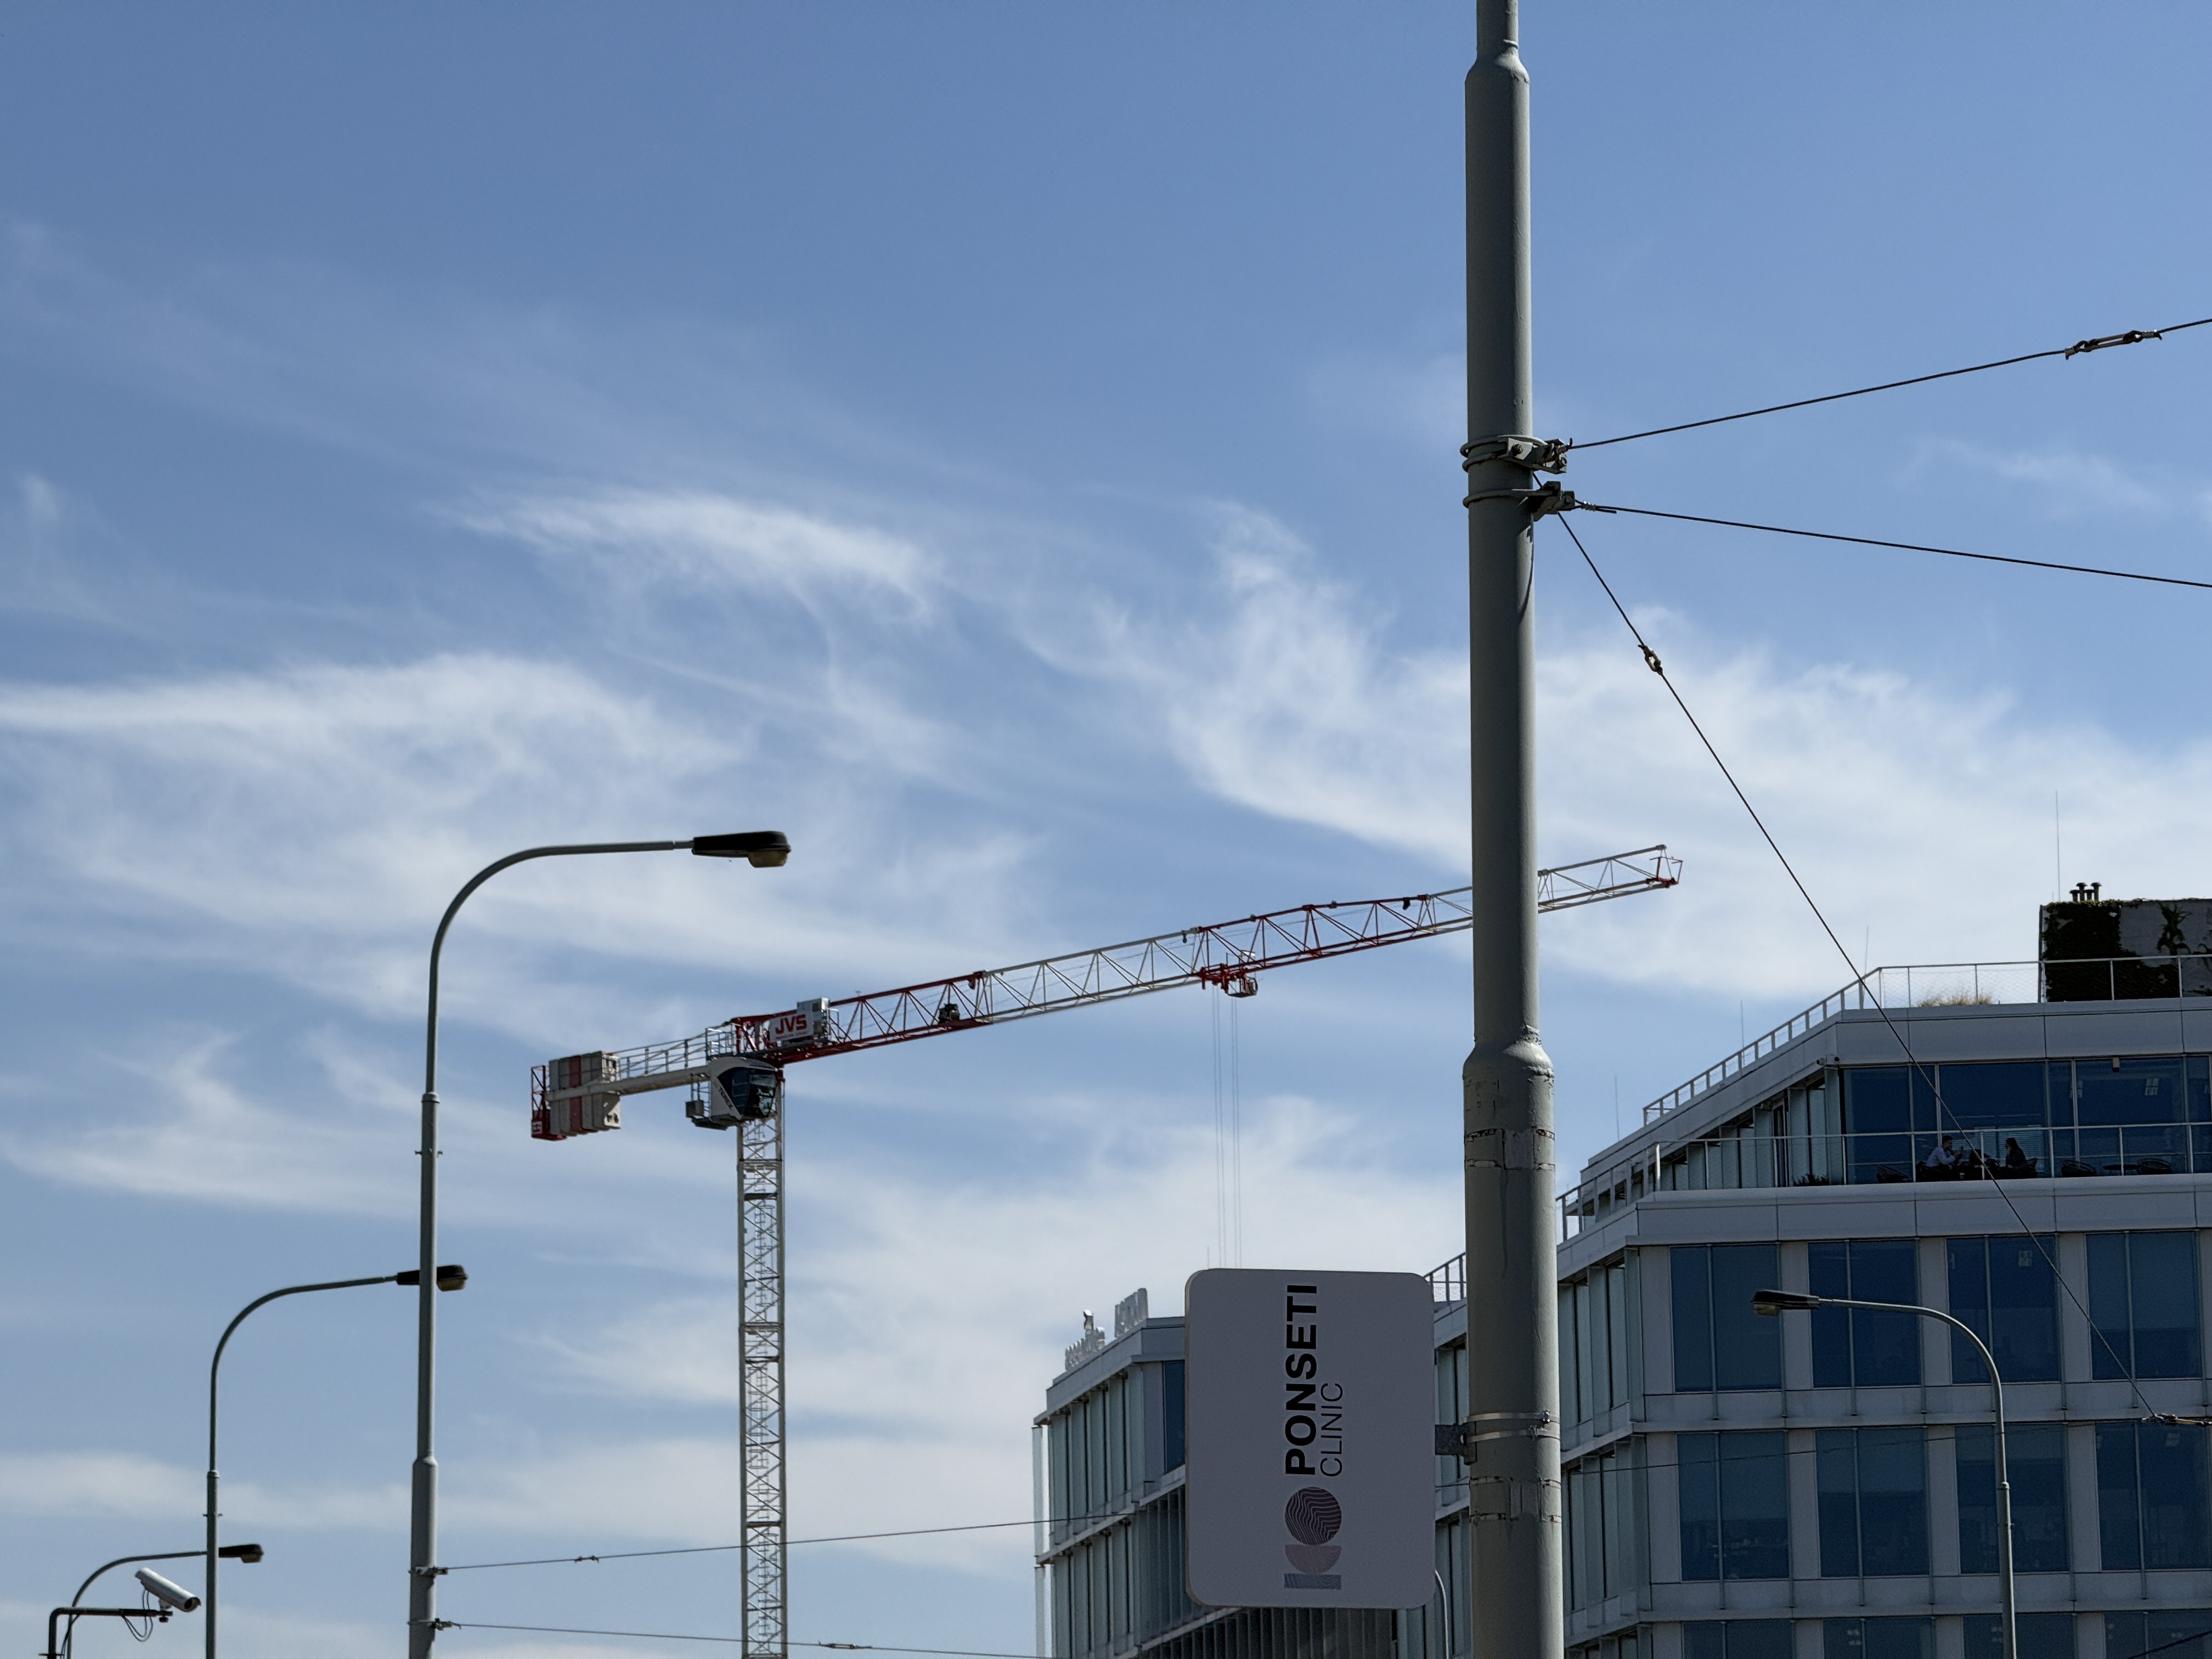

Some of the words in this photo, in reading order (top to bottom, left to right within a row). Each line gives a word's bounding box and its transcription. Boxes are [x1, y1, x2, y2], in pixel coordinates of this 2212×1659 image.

[775, 1014, 807, 1035] JVS
[1285, 1285, 1317, 1475] PONSETI
[1320, 1383, 1343, 1477] CLINIC
